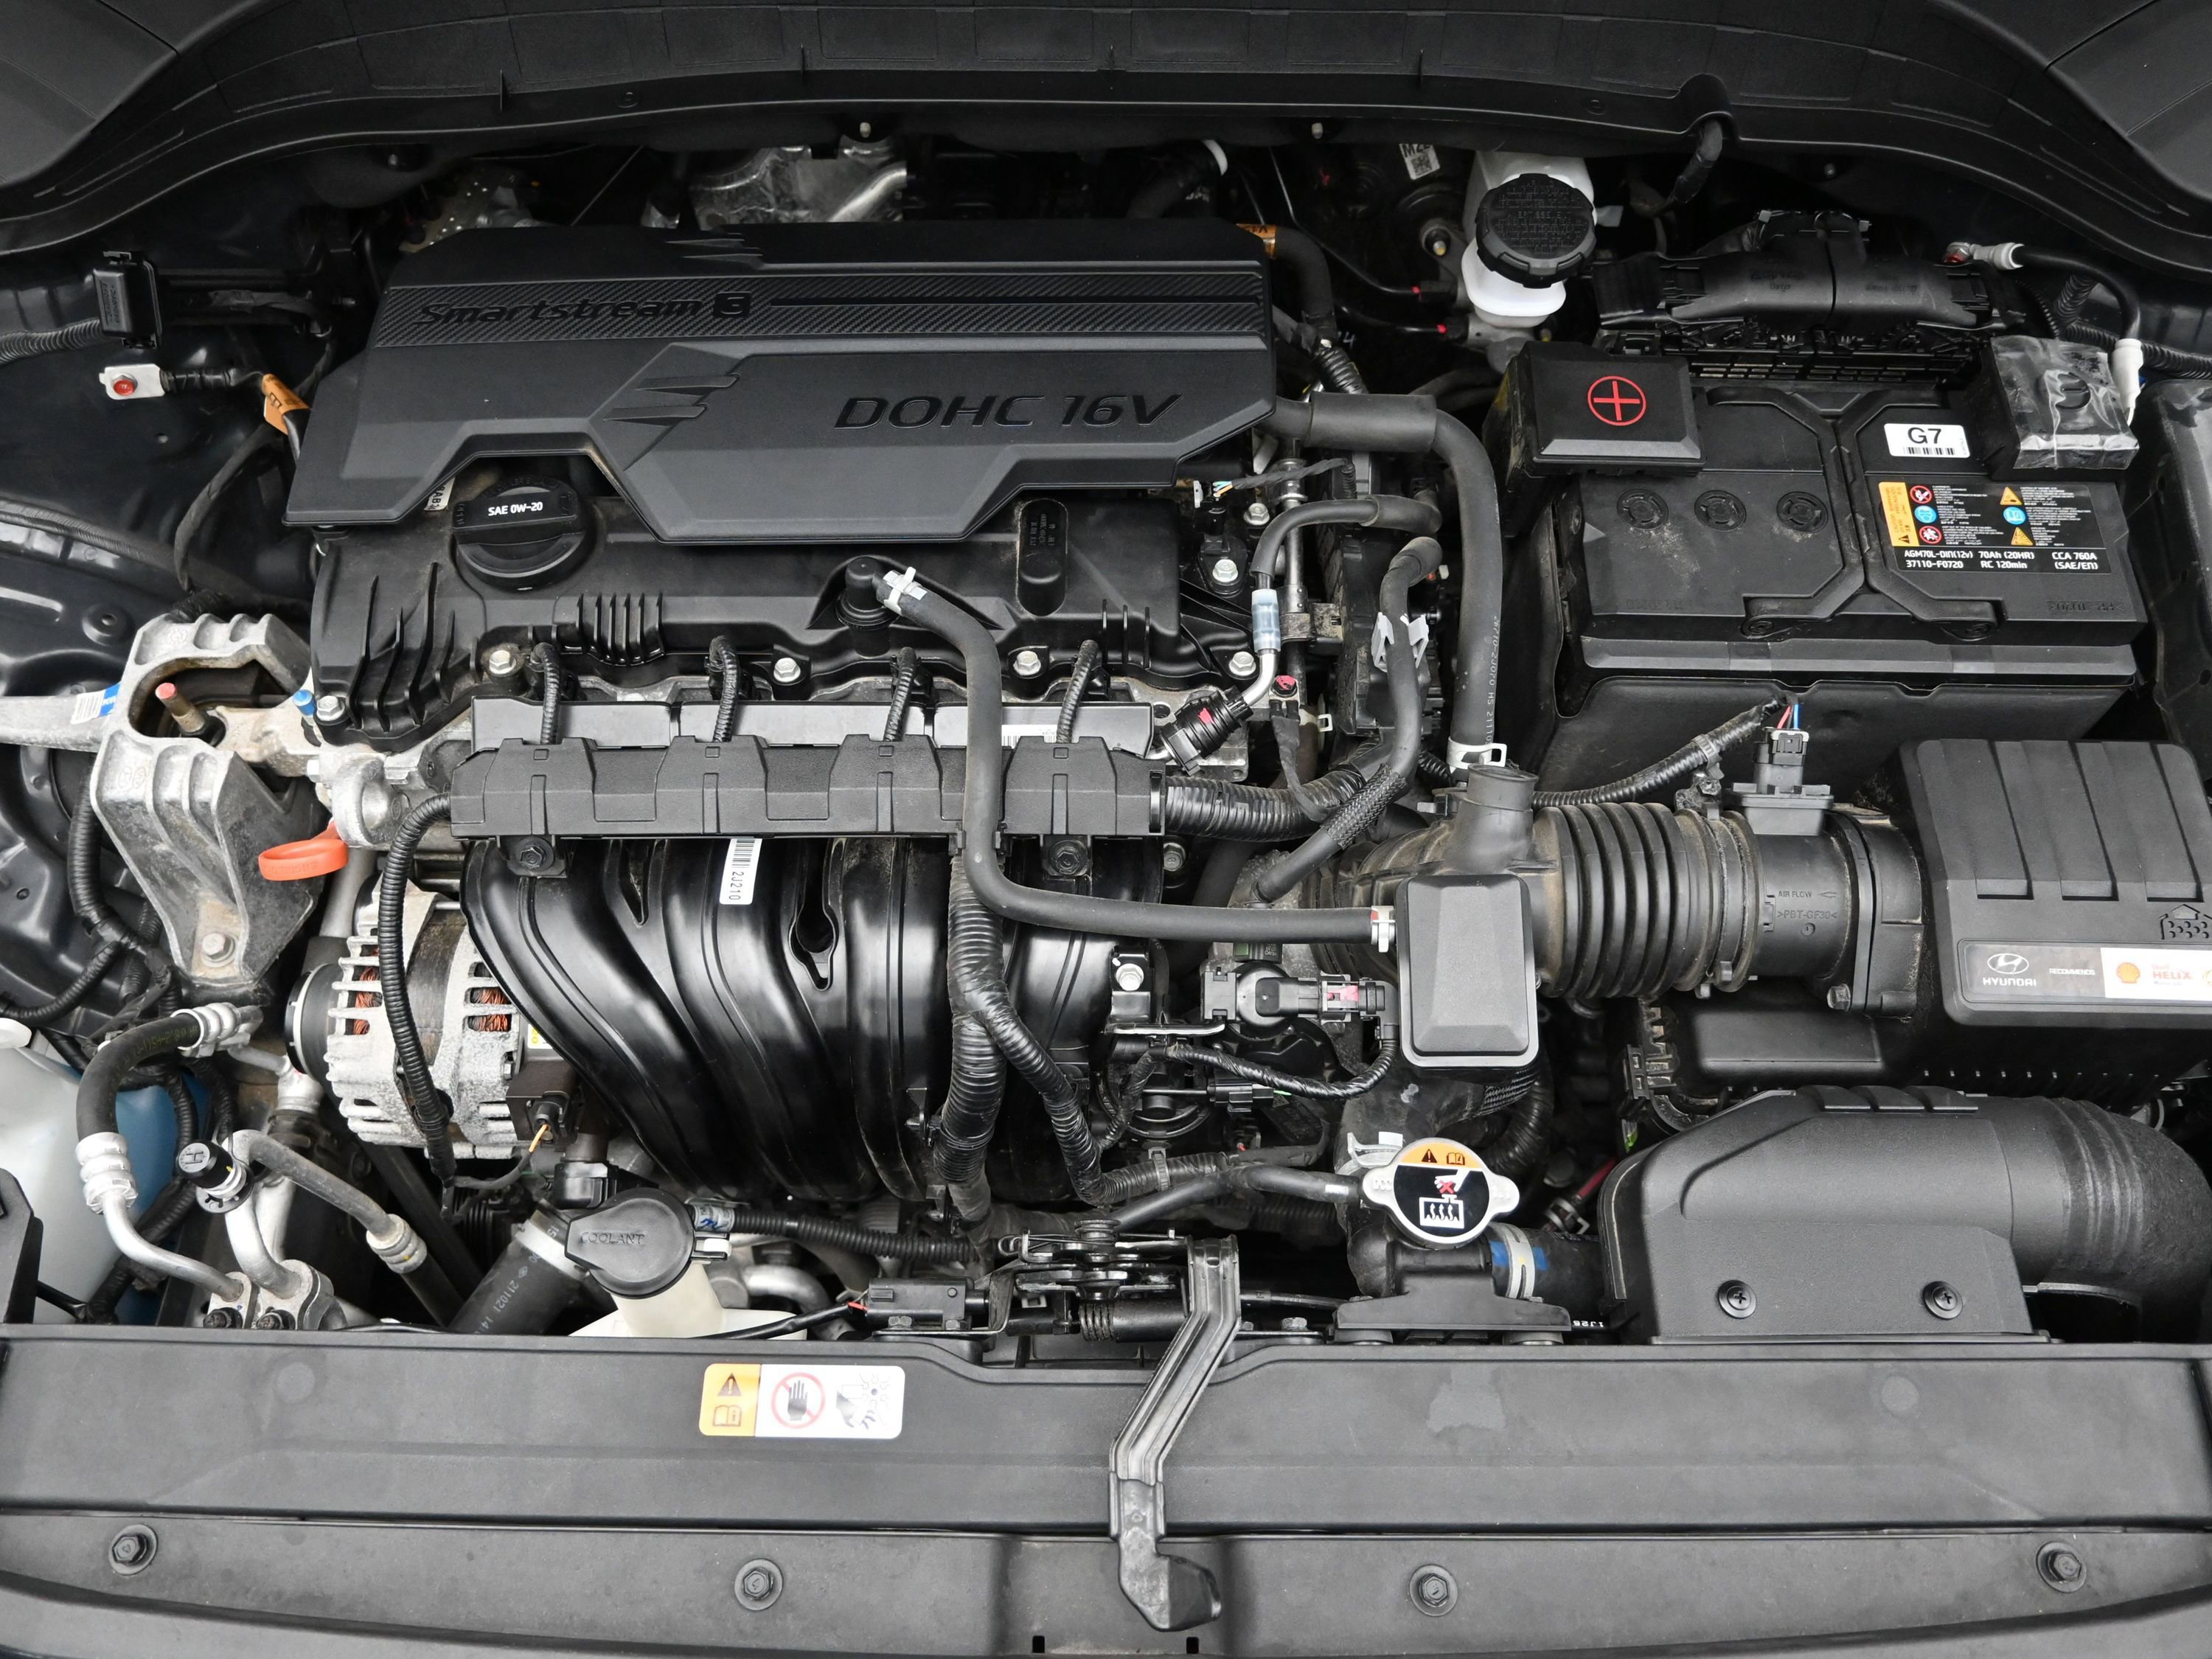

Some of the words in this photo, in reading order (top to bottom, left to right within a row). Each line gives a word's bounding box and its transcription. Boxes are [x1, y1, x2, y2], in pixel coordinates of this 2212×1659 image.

[414, 297, 702, 326] Smartstream
[834, 395, 1045, 430] DOHC
[1062, 394, 1183, 427] 16V
[1907, 427, 1941, 445] G7
[487, 504, 509, 516] SAE
[510, 501, 543, 514] 0W-20
[1978, 551, 2001, 559] 70Ah
[2004, 551, 2035, 560] (20HR)
[2051, 552, 2072, 560] CCA
[2073, 552, 2098, 560] 760A
[1905, 560, 1964, 568] 37110-F0720
[1980, 560, 1994, 568] RC
[1996, 560, 2028, 568] 120min
[1486, 692, 1495, 705] HS
[728, 871, 745, 900] 2J210
[1983, 977, 2037, 987] HYUNDAI
[2049, 967, 2096, 975] RECOMMENDS
[2152, 971, 2192, 980] HELIX
[580, 1231, 645, 1245] COOLANT
[493, 1279, 520, 1312] 211021
